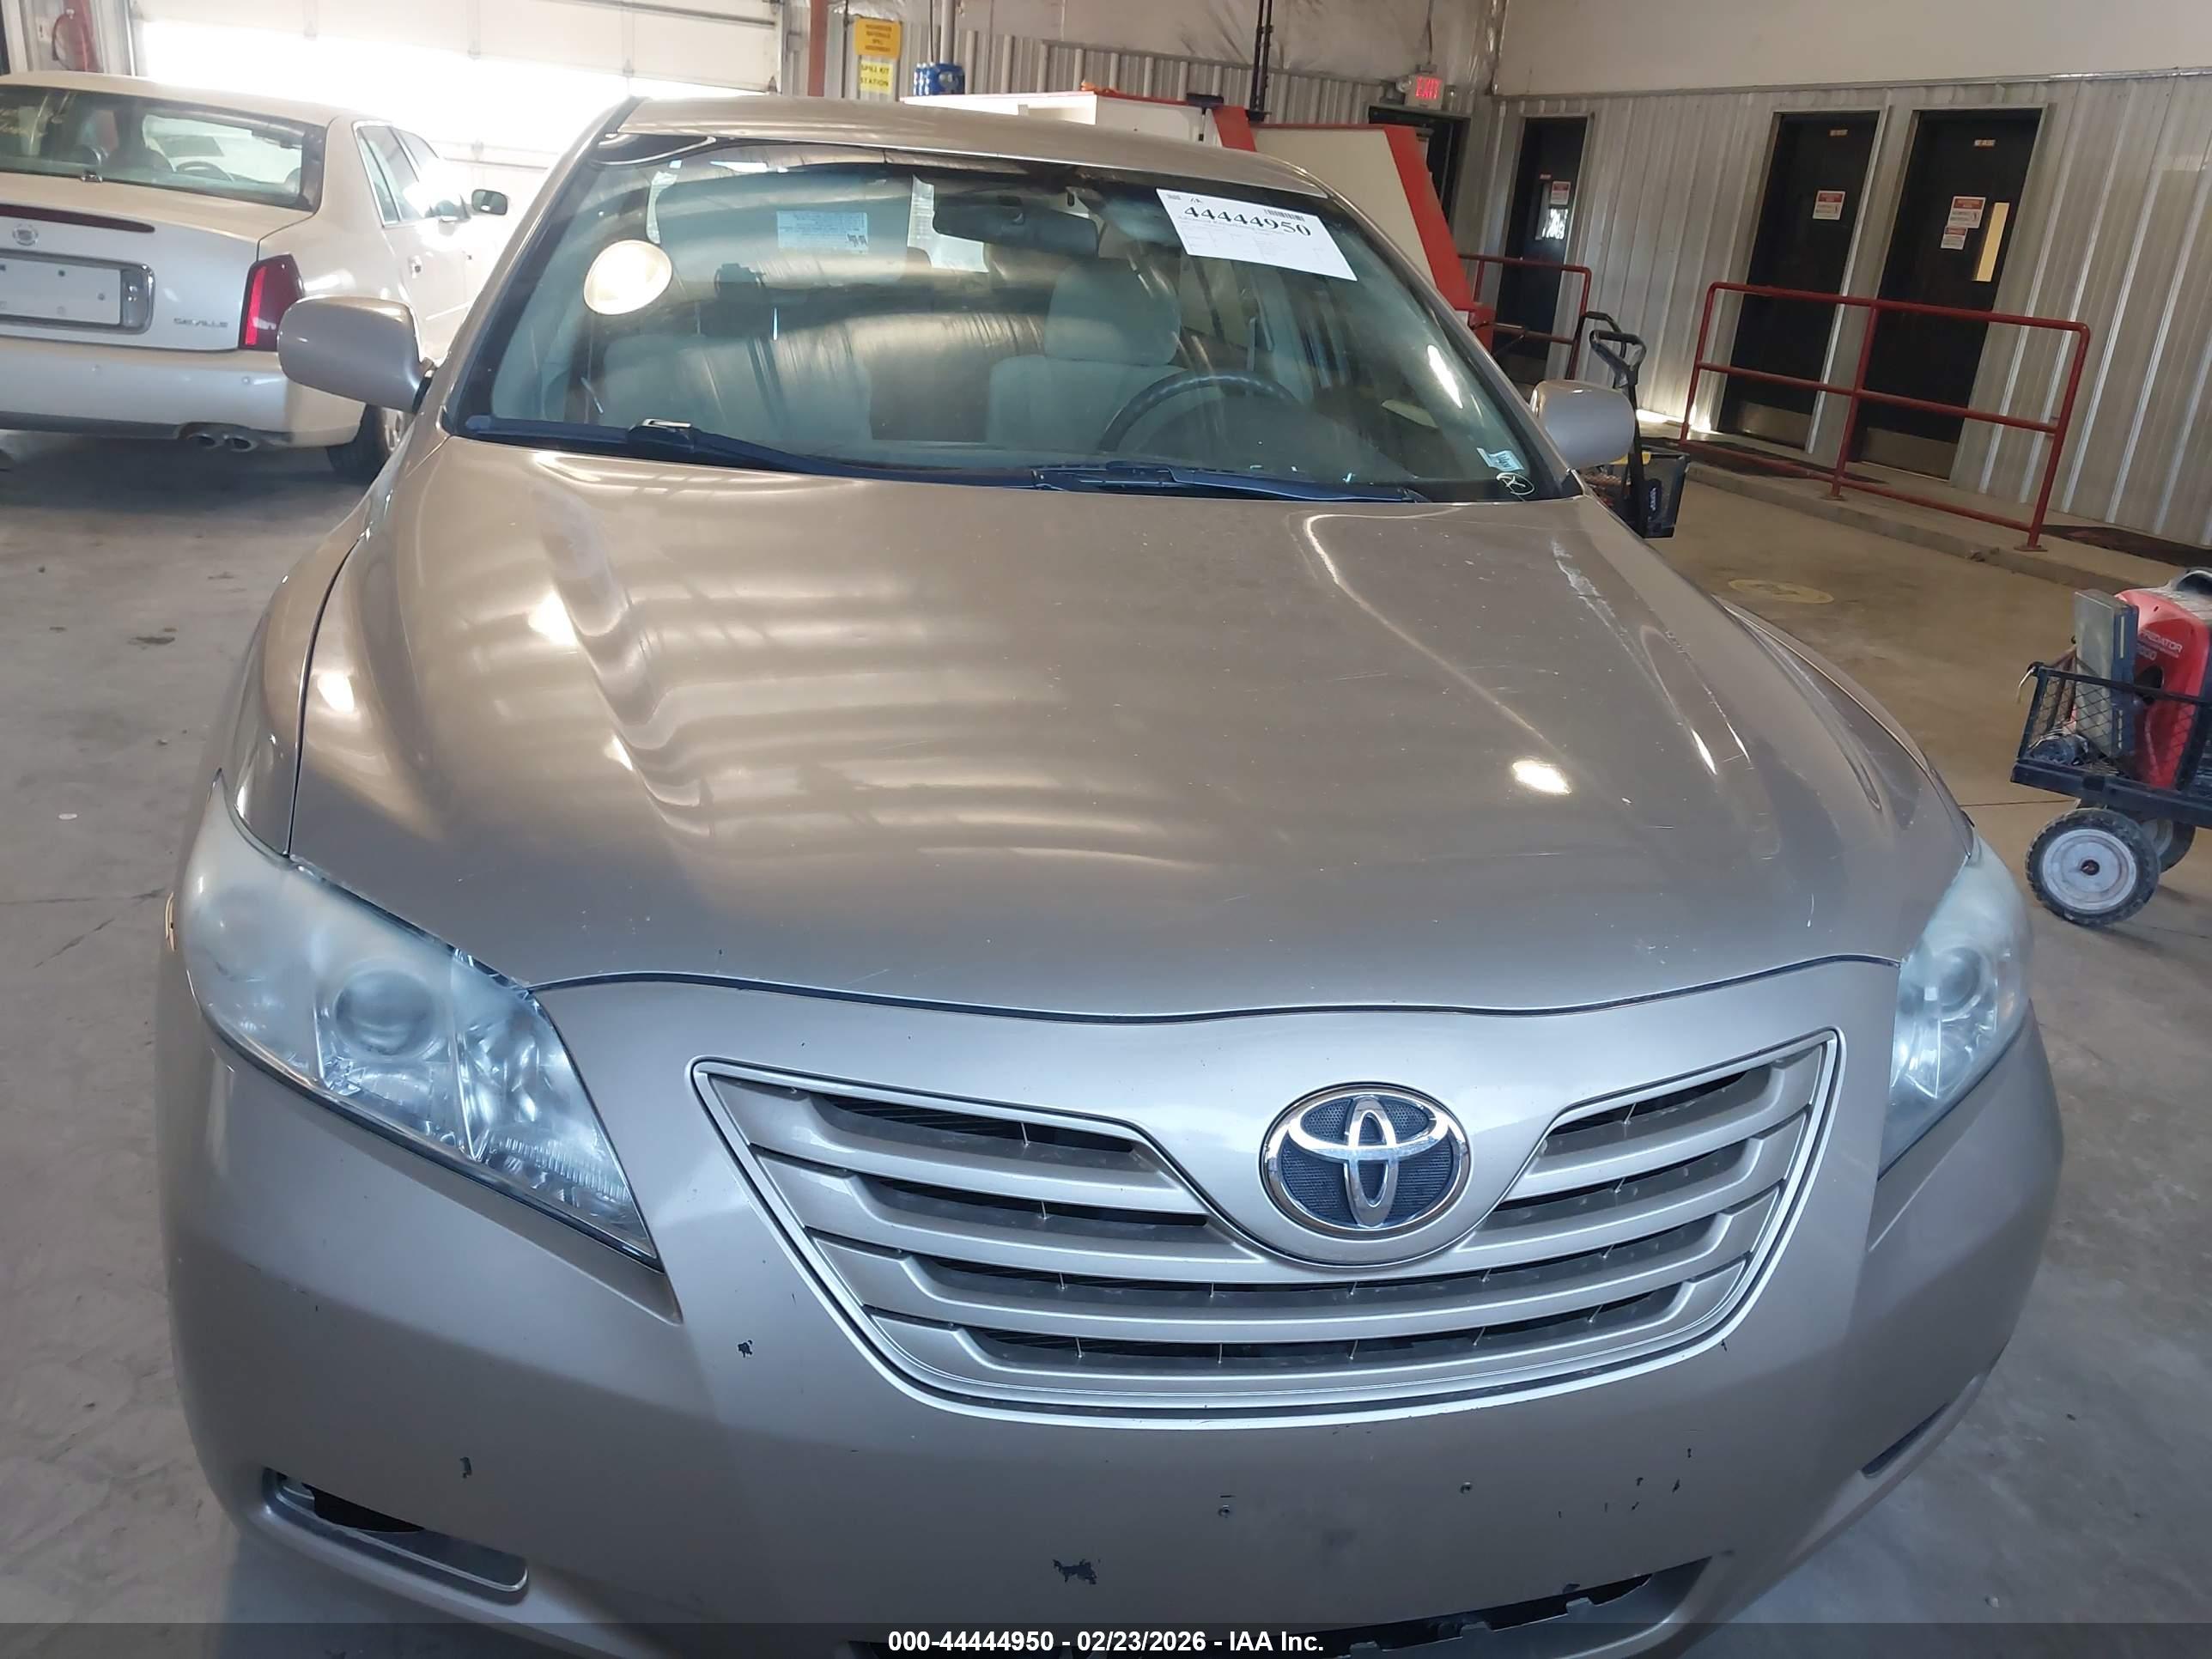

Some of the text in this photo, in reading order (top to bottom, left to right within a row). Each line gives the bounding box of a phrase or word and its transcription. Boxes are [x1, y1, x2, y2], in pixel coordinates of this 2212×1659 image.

[860, 77, 889, 87] STATION
[1416, 76, 1442, 99] EXIT
[1184, 207, 1311, 236] 44444950
[2138, 629, 2183, 653] PREDATOR
